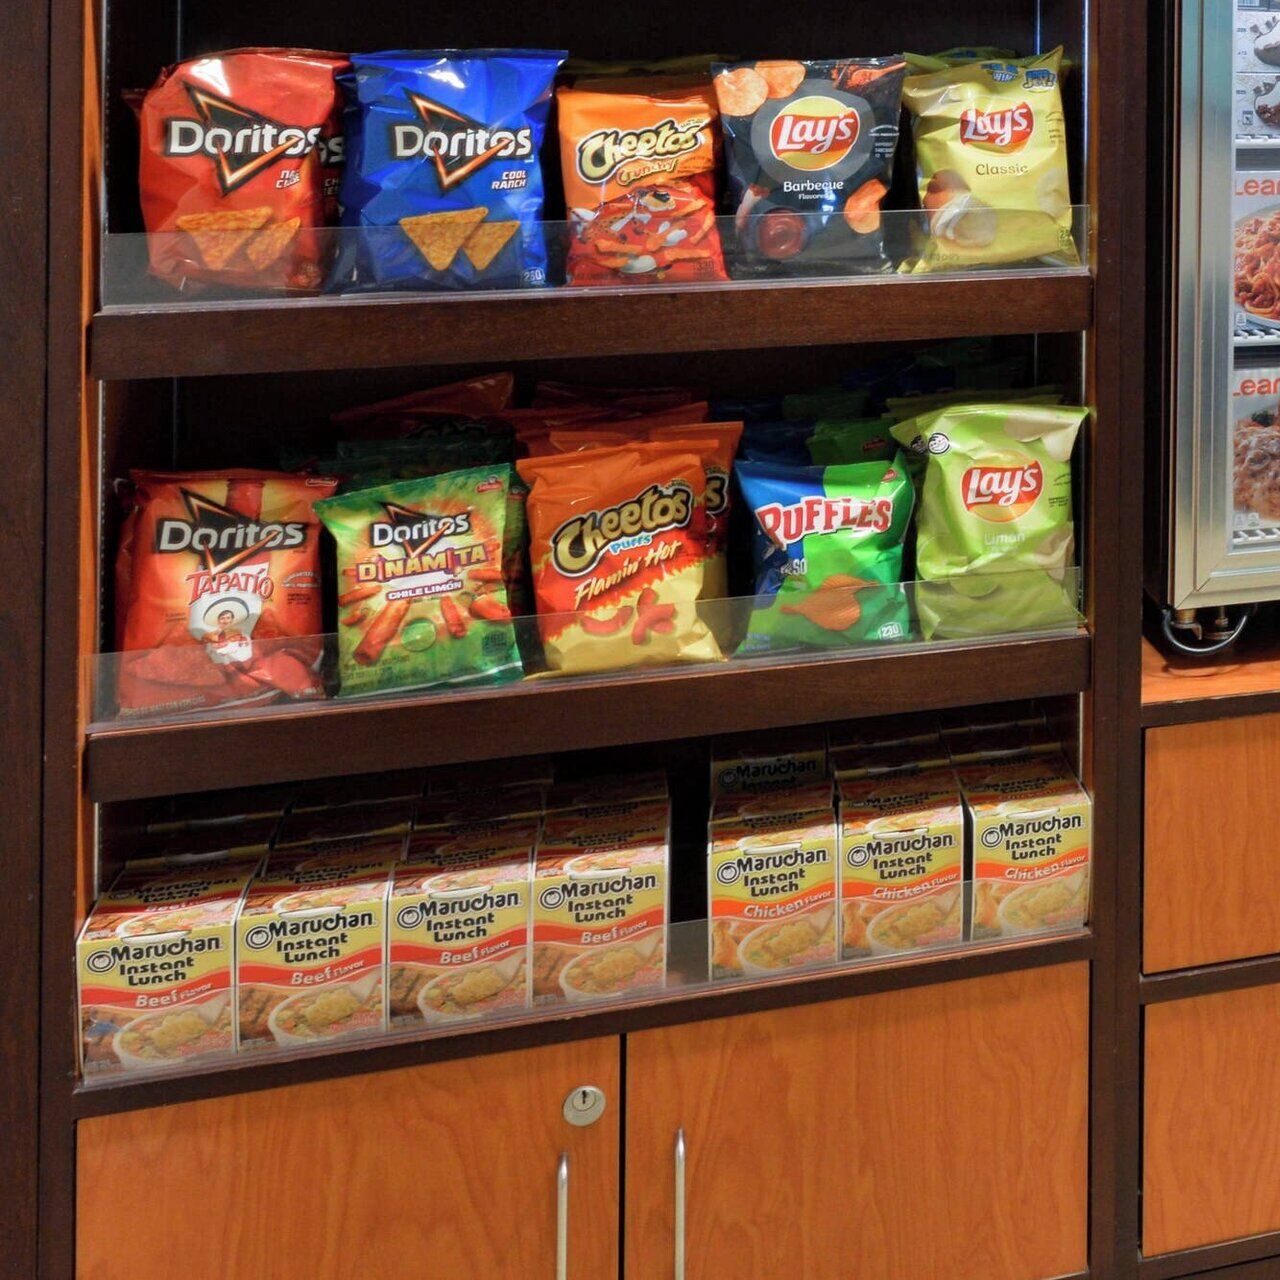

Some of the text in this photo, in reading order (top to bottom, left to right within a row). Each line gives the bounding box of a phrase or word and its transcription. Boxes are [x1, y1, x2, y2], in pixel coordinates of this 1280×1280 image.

[169, 120, 321, 156] Doritos
[777, 111, 858, 153] Lay's
[964, 109, 1030, 146] Lay's
[394, 124, 531, 158] Doritos
[578, 120, 702, 182] Cheetos
[502, 170, 525, 179] COOL
[976, 164, 1029, 176] Classic
[491, 180, 525, 189] RANCH
[783, 179, 844, 193] Barbecue
[968, 466, 1038, 506] Lay's
[159, 520, 304, 552] Doritos
[372, 513, 470, 548] Doritos
[553, 485, 691, 574] Cheetos
[756, 498, 893, 550] RUFFLES
[356, 543, 490, 582] DINAMITA
[643, 540, 681, 568] Hot
[388, 588, 423, 601] CHILE
[999, 815, 1082, 838] Maruchan
[865, 833, 953, 857] Maruchan
[1005, 833, 1062, 850] Instant
[1012, 846, 1056, 860] Lunch
[736, 848, 828, 872] Maruchan
[873, 851, 933, 870] Instant
[880, 864, 927, 879] Lunch
[1005, 854, 1087, 879] Chicken Flavor
[561, 875, 656, 898] Maruchan
[743, 869, 805, 886] Instant
[750, 881, 799, 897] Lunch
[873, 872, 959, 900] Chicken Flavor
[419, 892, 519, 916] Maruchan
[568, 894, 633, 912] Instant
[574, 907, 626, 923] Lunch
[743, 889, 834, 918] Chicken Flavor
[268, 912, 372, 937] Maruchan
[426, 913, 495, 931] Instant
[581, 920, 648, 944] Beef Flavor
[276, 933, 348, 952] Instant
[433, 927, 487, 943] Lunch
[111, 937, 220, 961] Maruchan
[284, 947, 340, 963] Lunch
[440, 939, 511, 964] Beef Flavor
[119, 956, 194, 975] Instant
[291, 960, 364, 984] Beef Flavor
[128, 970, 187, 987] Lunch
[135, 983, 212, 1007] Beef Flavor
